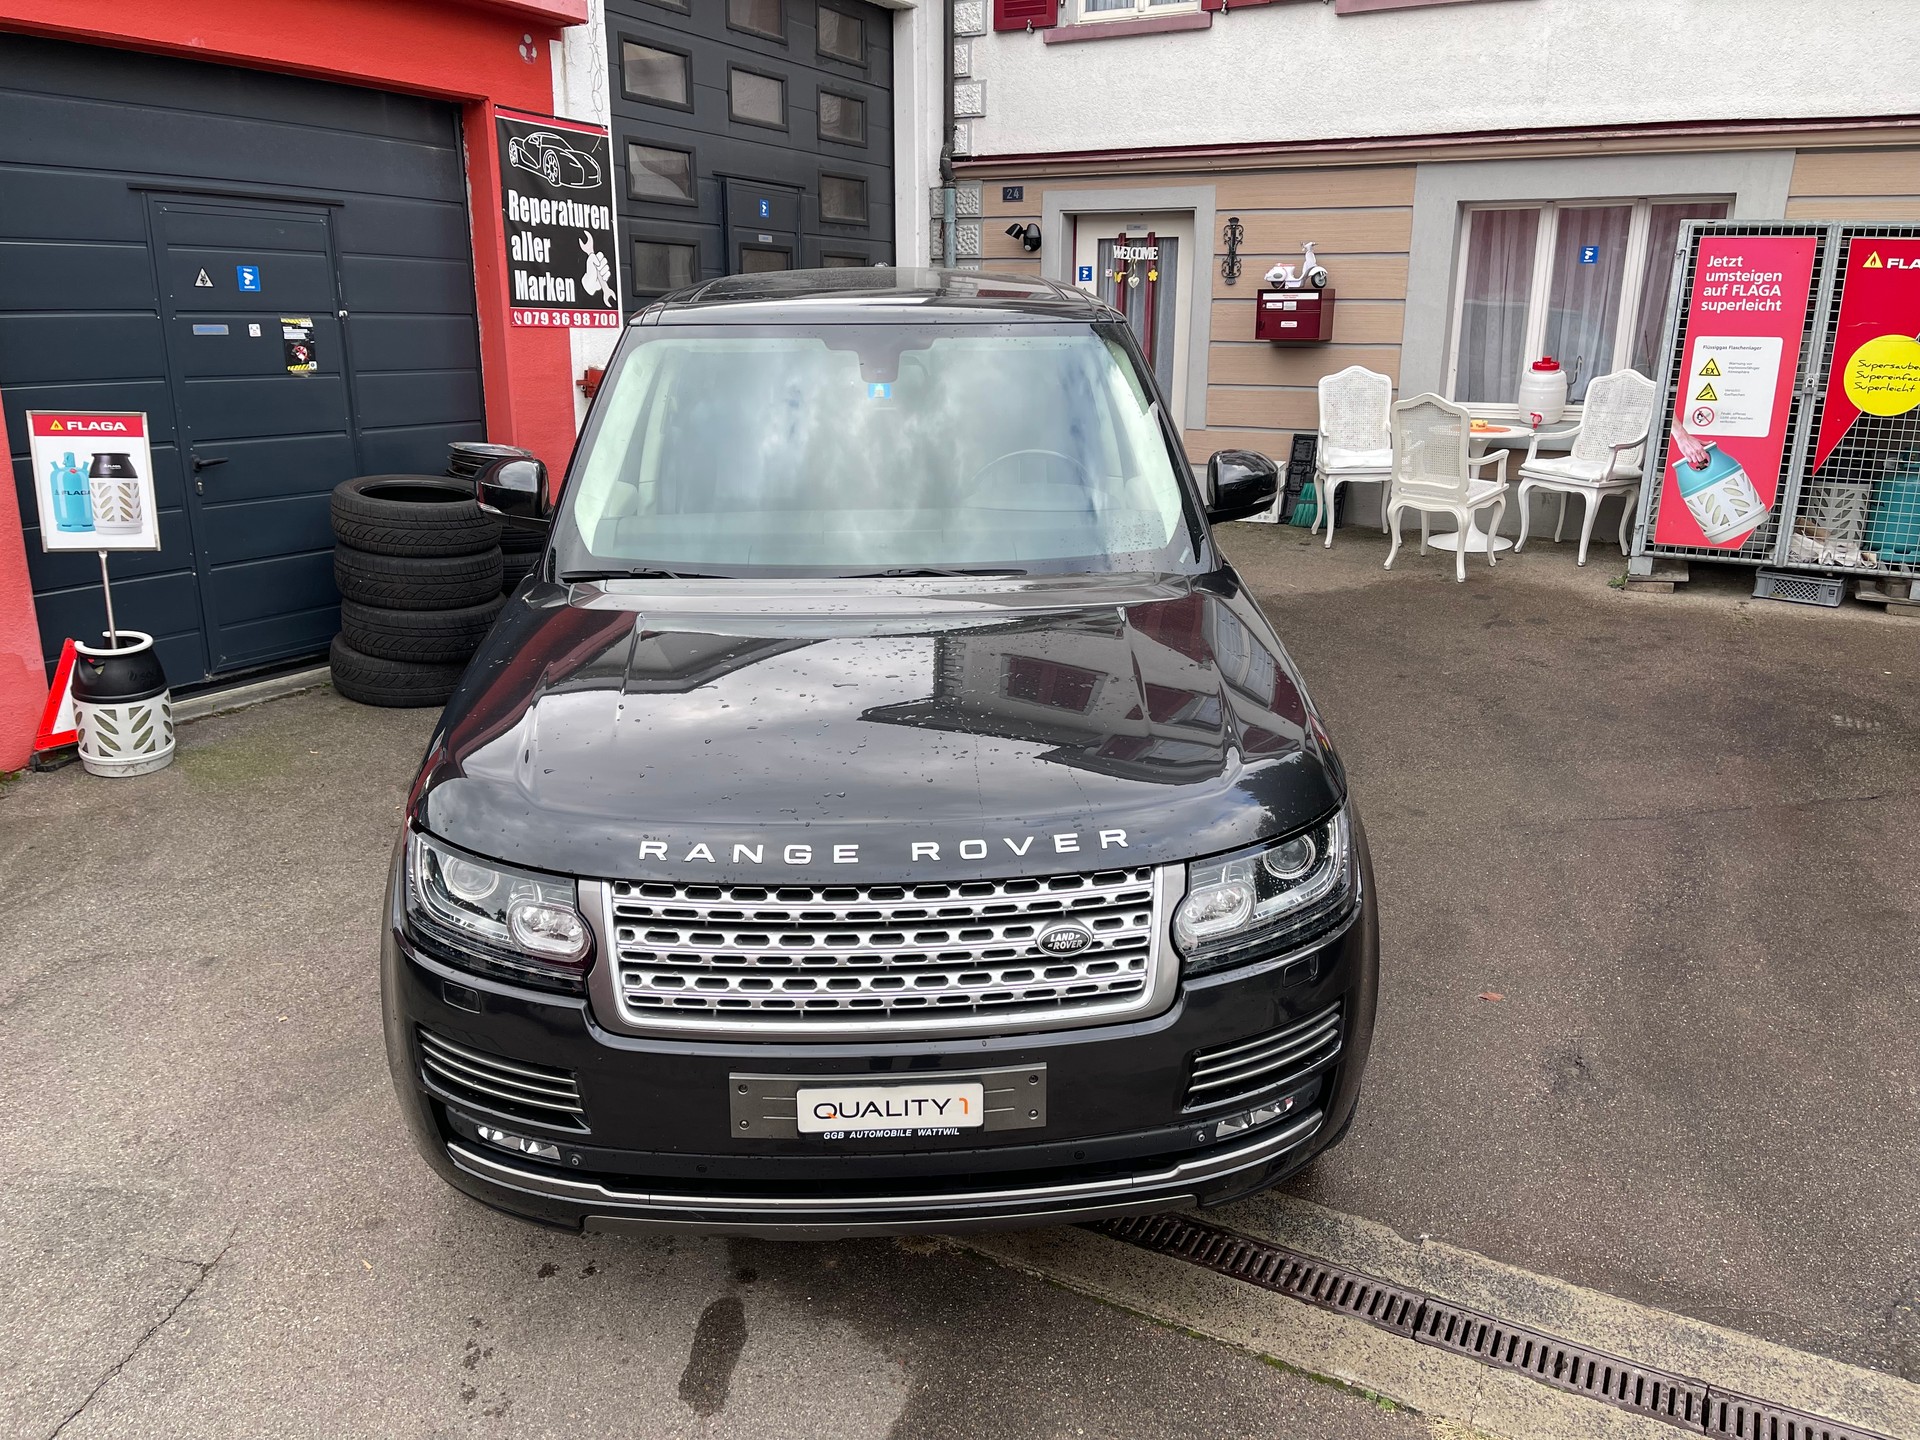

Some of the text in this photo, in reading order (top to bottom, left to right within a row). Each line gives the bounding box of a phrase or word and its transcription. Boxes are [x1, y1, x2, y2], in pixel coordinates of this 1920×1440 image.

[1006, 188, 1020, 199] 24
[508, 189, 610, 231] Reperaturen
[511, 231, 551, 264] aller
[1113, 245, 1159, 260] WELCOME
[1706, 255, 1744, 268] Jetzt
[1886, 257, 1920, 269] FLA
[1705, 269, 1783, 285] umsteigen
[514, 269, 576, 303] Marken
[1703, 284, 1782, 297] auf FLAGA
[1701, 298, 1783, 314] superleicht
[523, 311, 617, 326] 079 36 98 700
[1705, 367, 1715, 375] EX
[1857, 359, 1920, 372] Supersaube
[1855, 370, 1920, 383] Supereinfac
[1853, 381, 1916, 394] Superleicht
[66, 420, 128, 432] FLAGA
[638, 828, 1129, 865] RANGE ROVER
[1050, 932, 1075, 942] LAND
[1053, 939, 1083, 950] ROVER
[813, 1097, 969, 1120] QUALITY 1
[823, 1127, 960, 1140] GGB AUTOMOBILE WATTWIL
